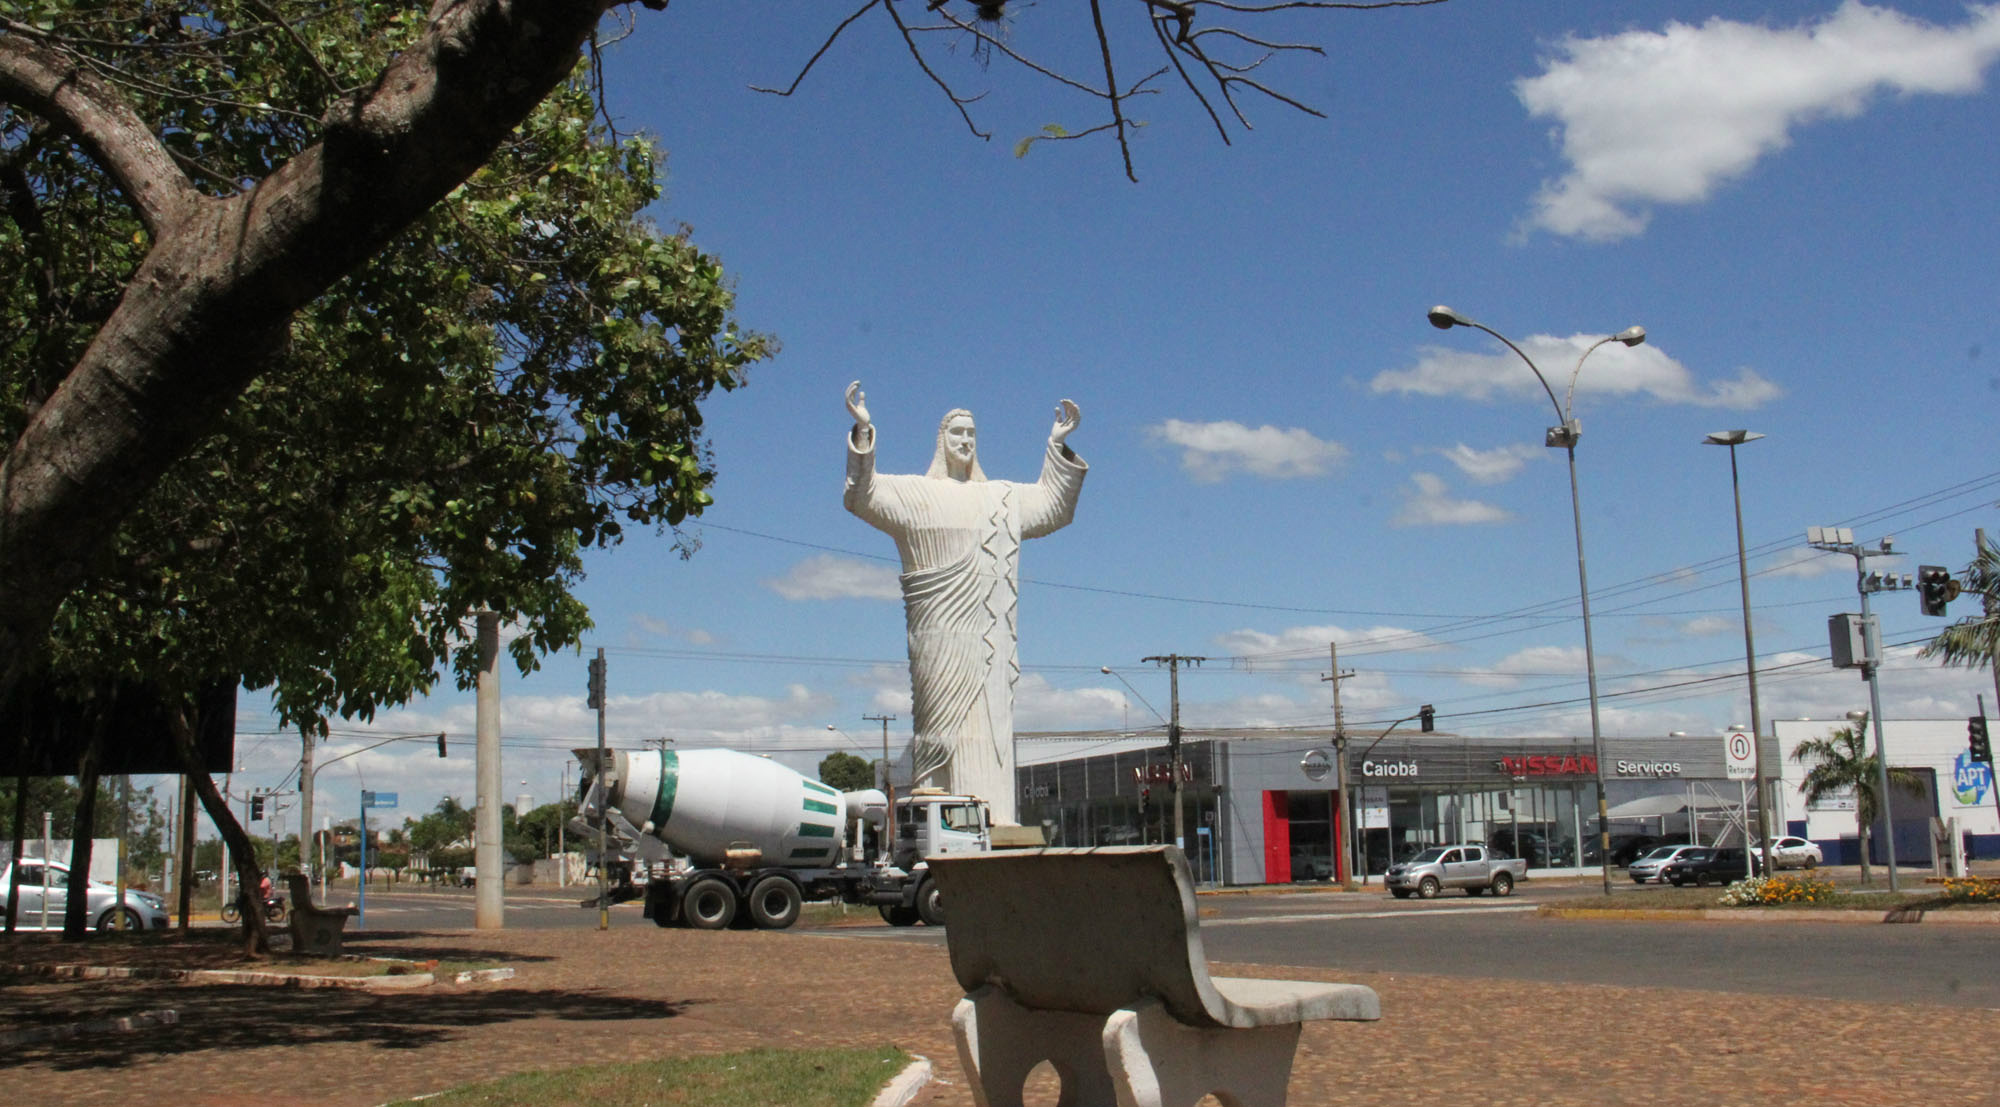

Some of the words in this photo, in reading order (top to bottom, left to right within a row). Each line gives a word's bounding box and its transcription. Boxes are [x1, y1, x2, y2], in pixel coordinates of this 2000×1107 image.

[1362, 759, 1418, 777] Caiobá
[1502, 755, 1598, 775] NISSAN
[1617, 760, 1681, 779] Serviços
[1728, 765, 1756, 775] Retorno
[1957, 767, 1985, 787] APT
